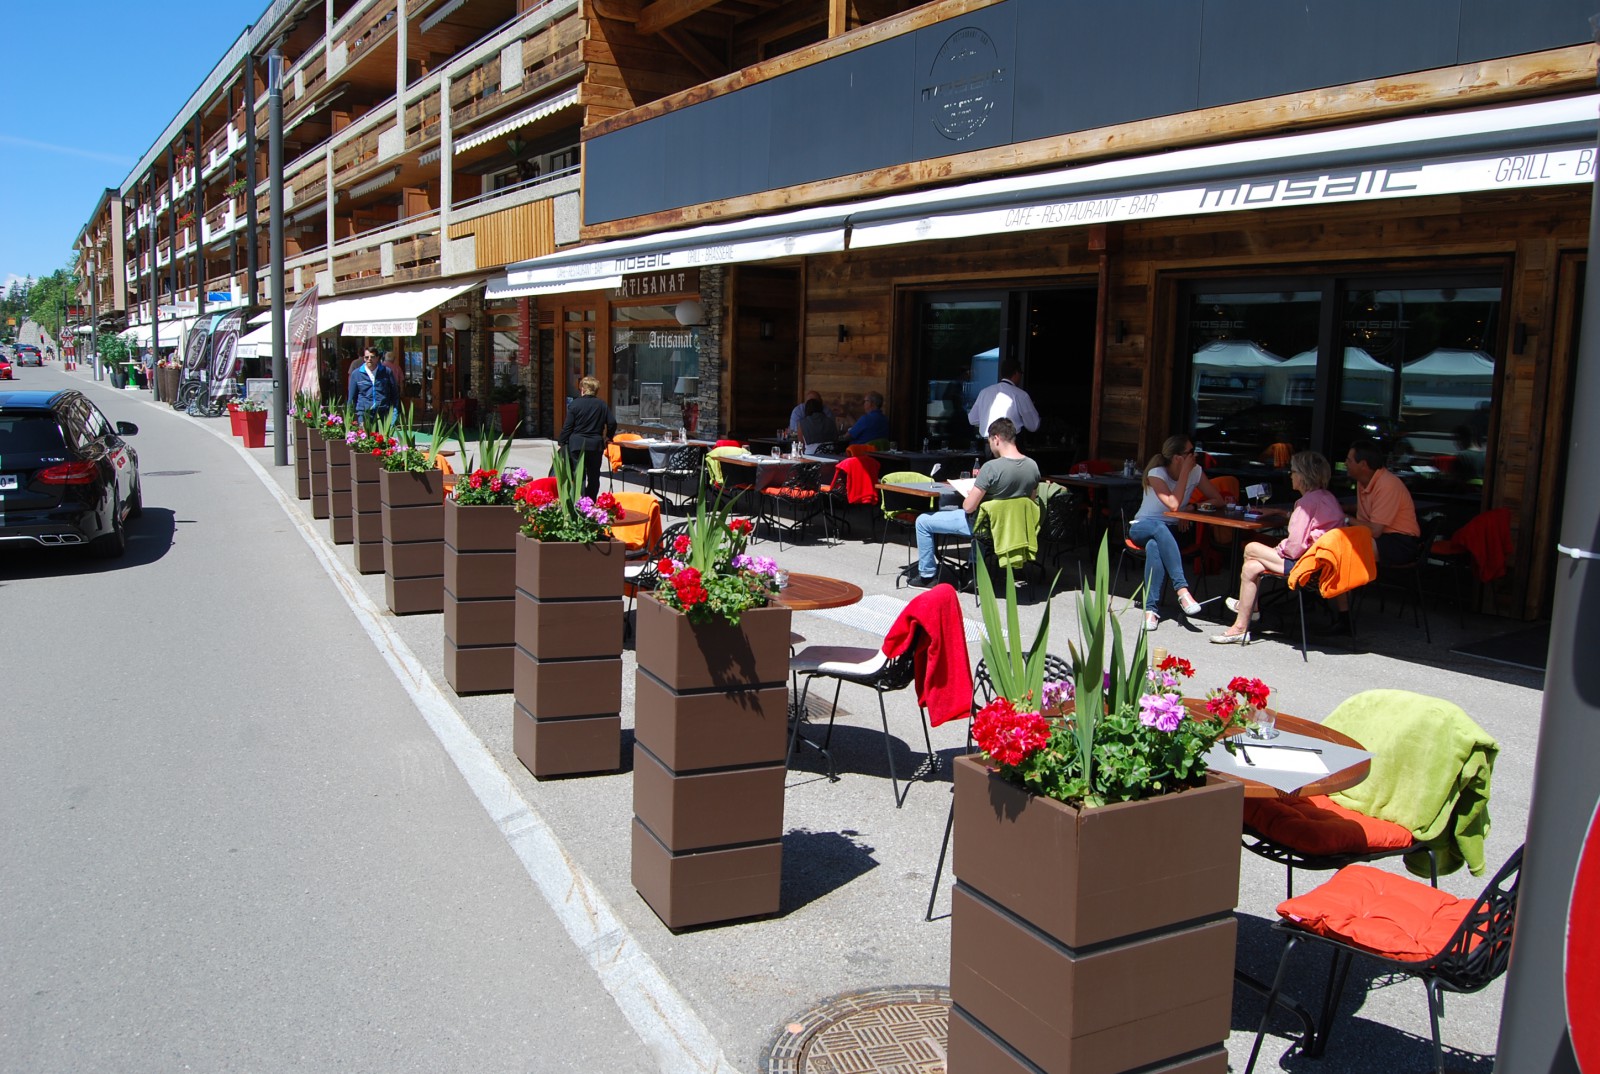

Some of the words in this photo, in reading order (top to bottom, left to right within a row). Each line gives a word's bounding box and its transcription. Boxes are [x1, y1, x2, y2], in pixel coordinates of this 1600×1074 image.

[1495, 154, 1551, 182] GRILL
[1041, 199, 1121, 223] RESTAURANT
[1128, 194, 1158, 215] BAR
[614, 273, 685, 297] ARTISANAT
[649, 331, 693, 349] Artisanat
